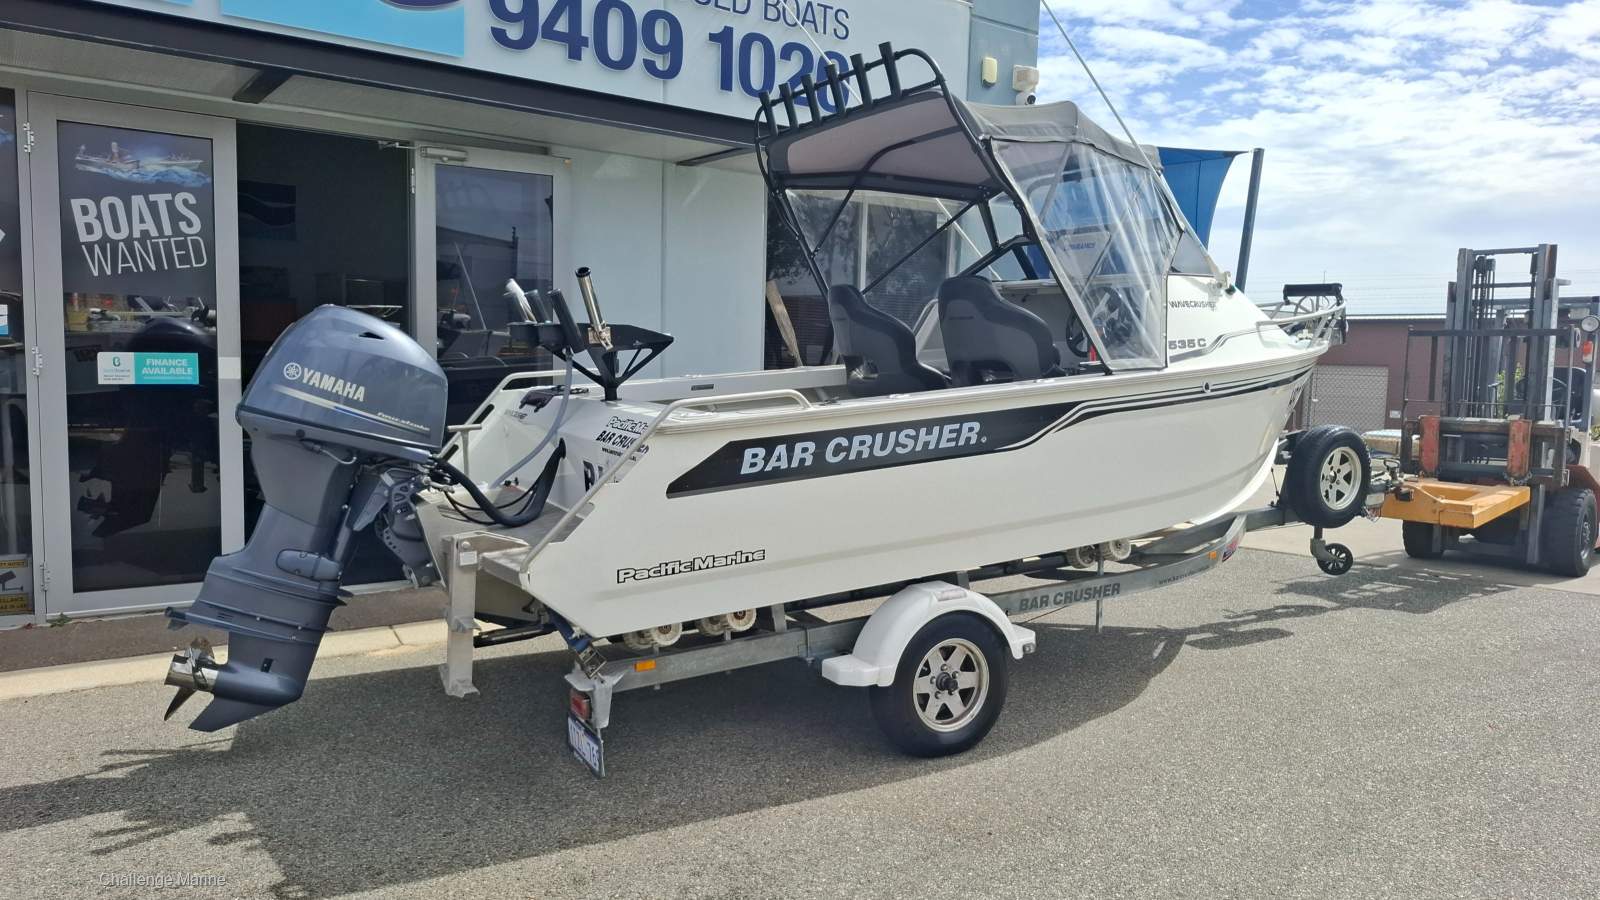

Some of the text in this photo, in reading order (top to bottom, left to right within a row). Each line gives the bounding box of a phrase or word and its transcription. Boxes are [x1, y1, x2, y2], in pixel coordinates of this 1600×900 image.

[764, 0, 850, 40] BOATS
[490, 0, 684, 80] 9409
[70, 191, 202, 242] BOATS
[82, 236, 207, 277] WANTED
[142, 367, 193, 375] AVAILABLE
[145, 358, 188, 367] FINANCE
[302, 367, 366, 402] YAMAHA
[596, 430, 616, 444] BAR
[740, 441, 816, 475] BAR
[617, 549, 766, 584] Pacific Marine
[1019, 583, 1121, 612] BAR CRUSHER
